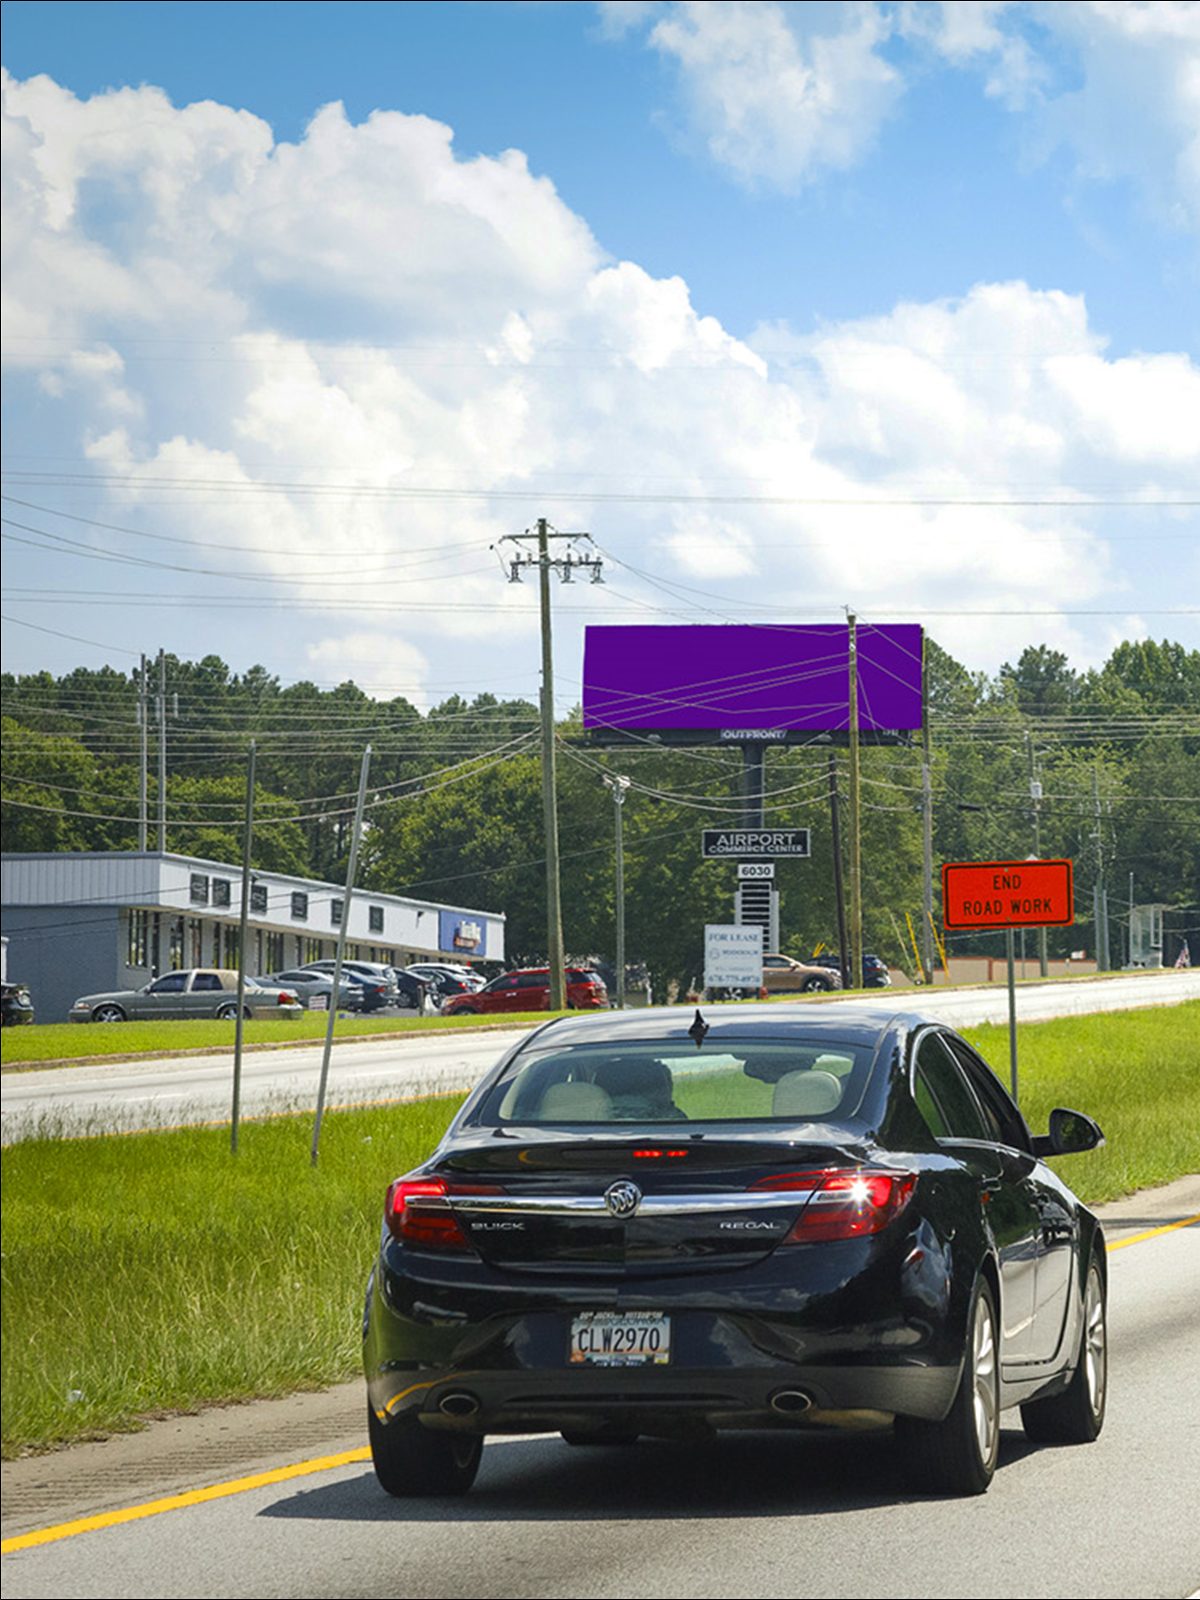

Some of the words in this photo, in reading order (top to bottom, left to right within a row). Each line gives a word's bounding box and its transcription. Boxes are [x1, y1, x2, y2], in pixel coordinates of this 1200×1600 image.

[723, 730, 783, 739] OUTFRONT
[716, 833, 796, 846] AIRPORT
[708, 845, 766, 854] COMMERCE
[767, 844, 803, 853] CENTER
[741, 866, 771, 876] 6030
[992, 874, 1021, 890] END
[963, 900, 1003, 916] ROAD
[1010, 898, 1052, 914] WORK
[709, 933, 728, 942] FOR
[730, 933, 758, 942] LEASE
[471, 1222, 526, 1231] BUICK
[719, 1221, 781, 1230] REGAL
[577, 1327, 660, 1352] CLW2970
